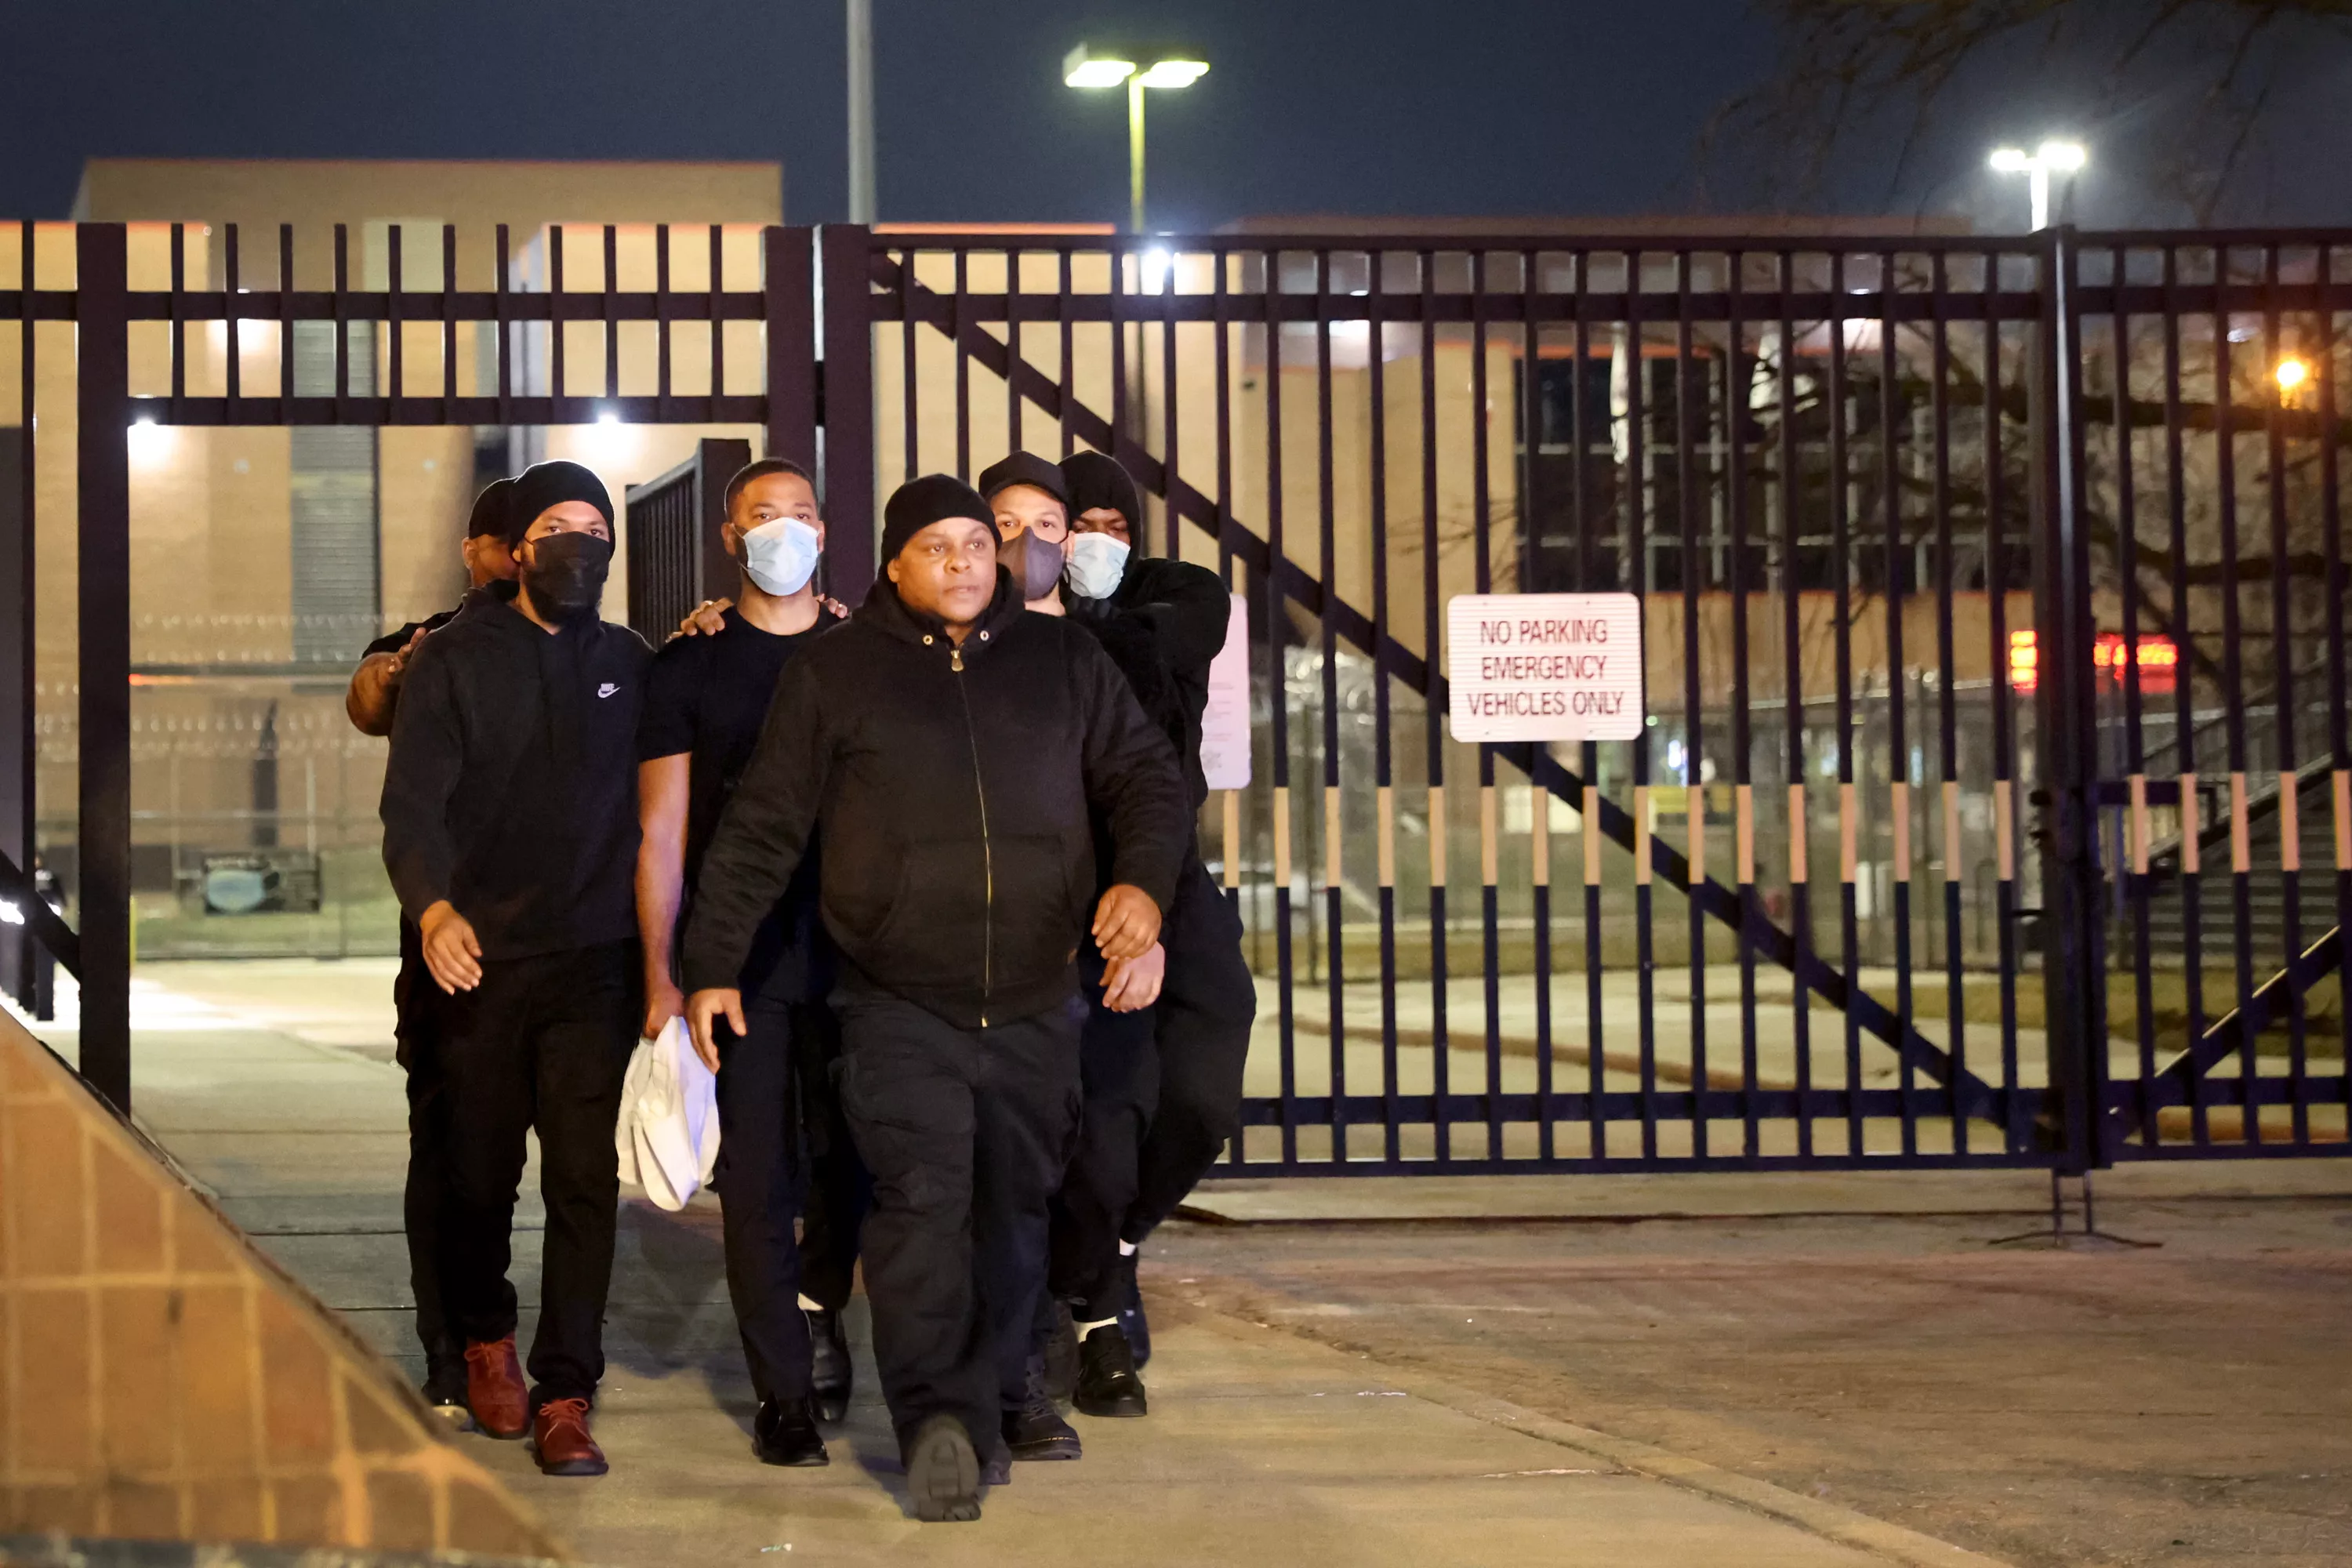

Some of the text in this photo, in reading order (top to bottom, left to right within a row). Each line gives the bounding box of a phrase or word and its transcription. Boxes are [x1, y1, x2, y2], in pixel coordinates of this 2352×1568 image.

[1480, 619, 1607, 644] NO PARKING
[1482, 655, 1606, 681] EMERGENCY
[1467, 691, 1624, 716] VEHICLES ONLY
